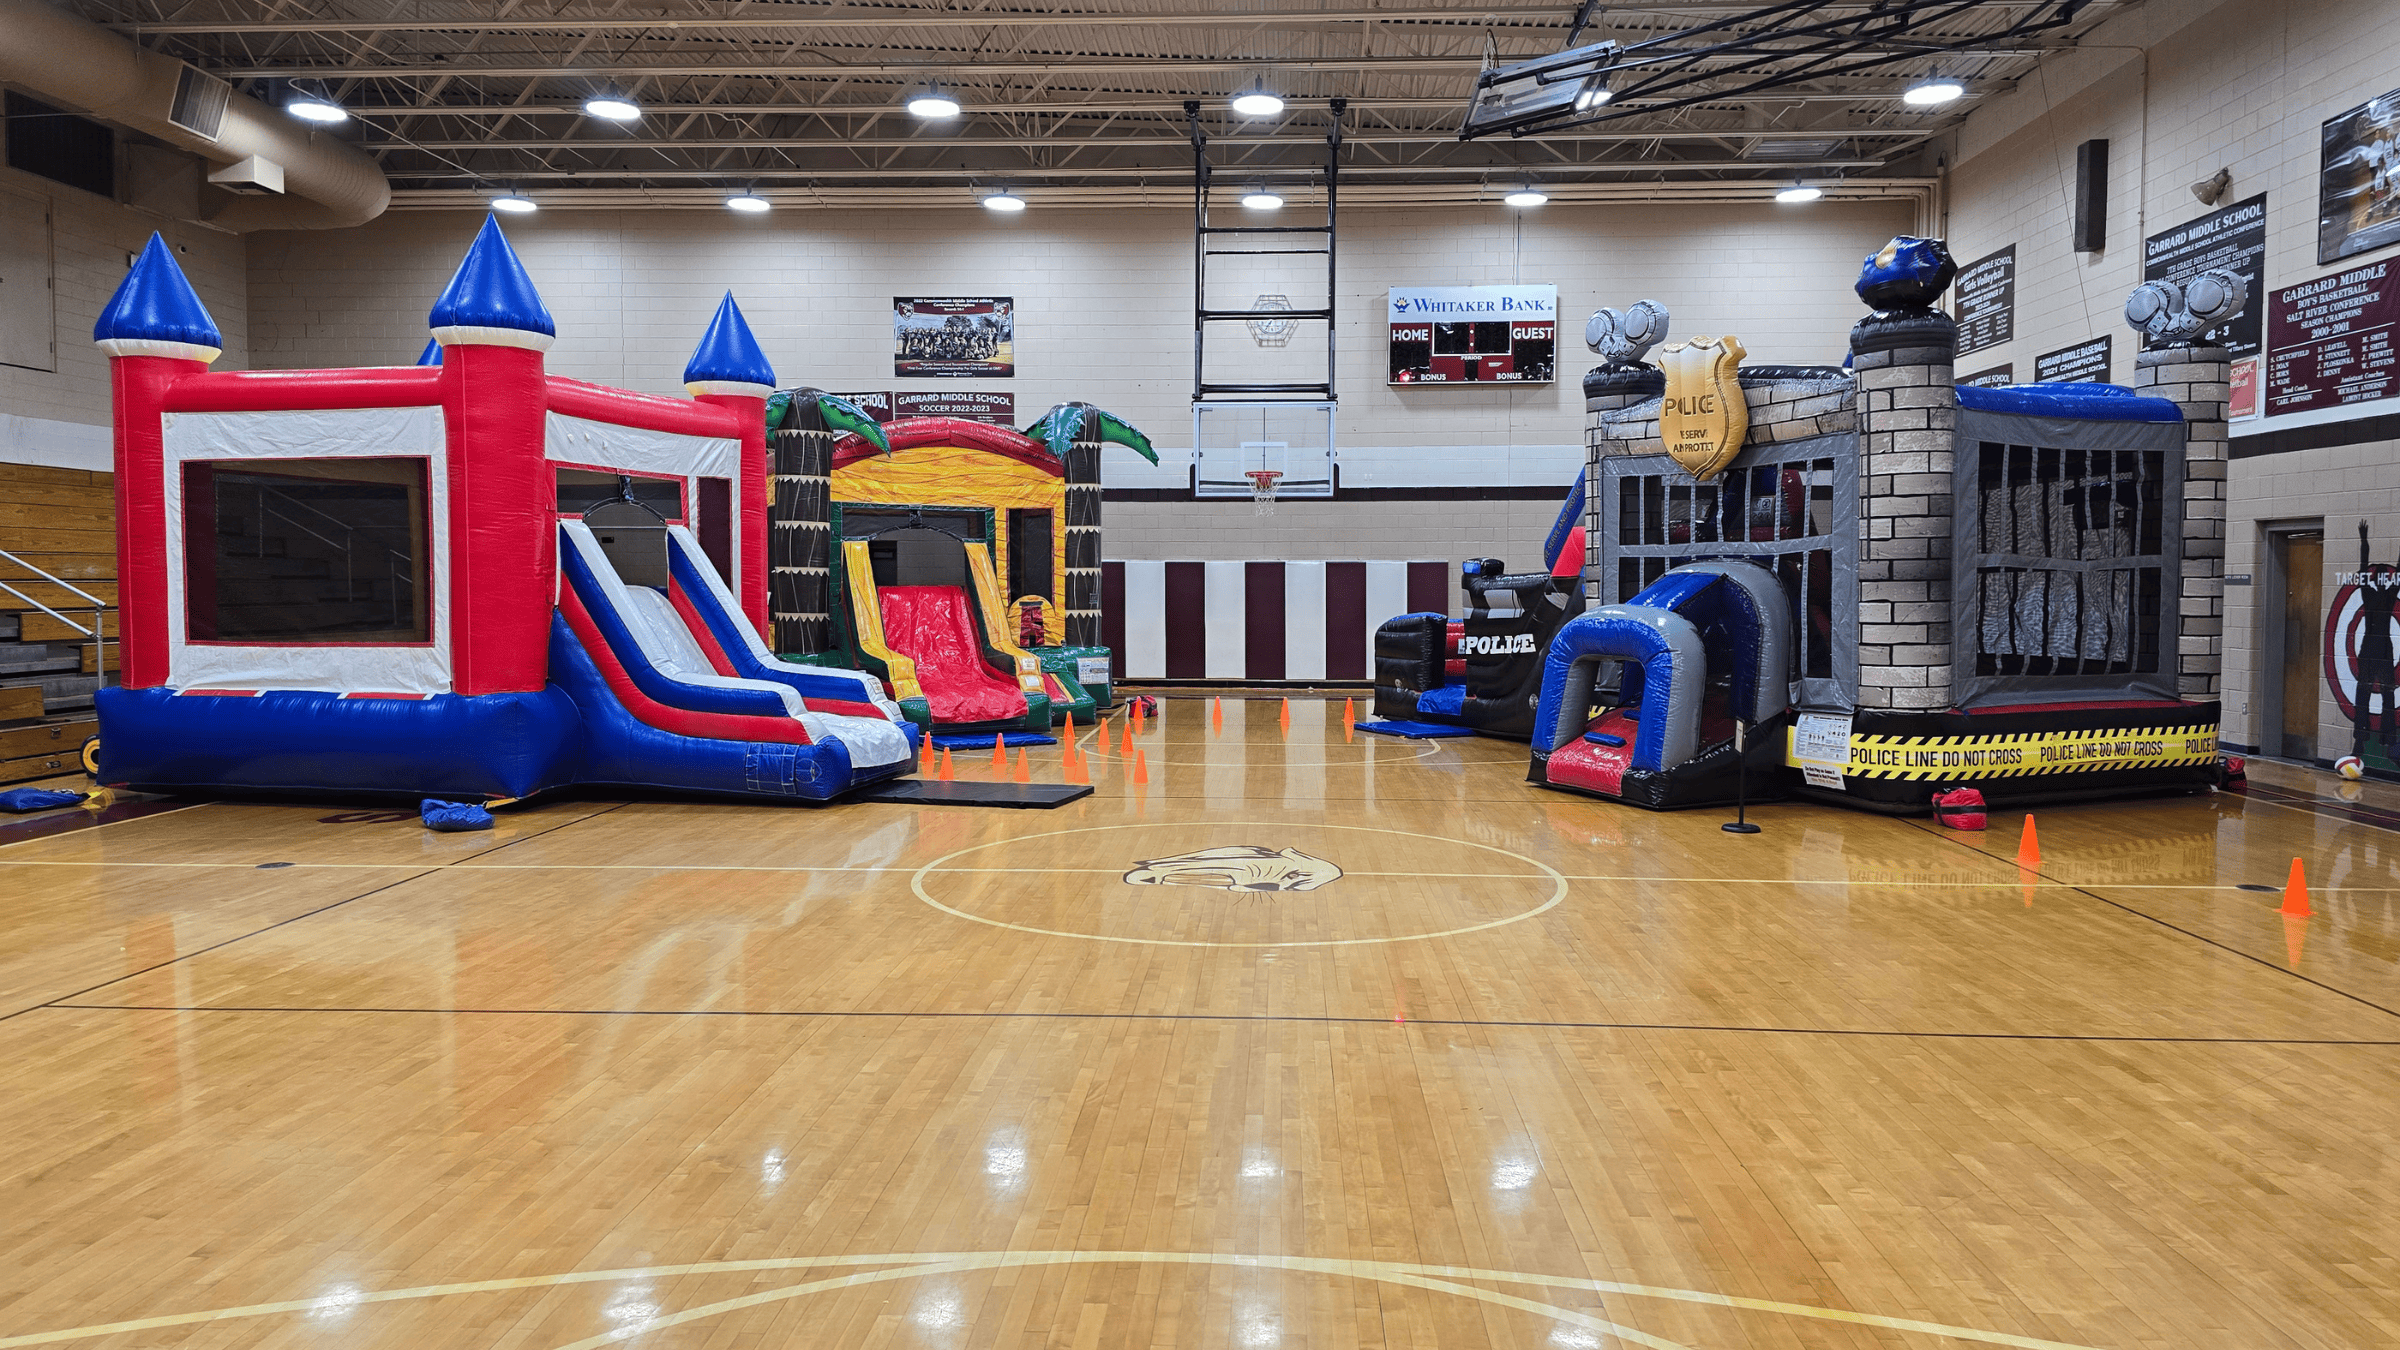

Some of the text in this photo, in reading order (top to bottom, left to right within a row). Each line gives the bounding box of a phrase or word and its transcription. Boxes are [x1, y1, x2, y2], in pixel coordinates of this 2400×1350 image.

[2148, 204, 2262, 256] GARRARD MIDDLE SCHOOL
[2179, 244, 2194, 254] MIDDLE
[2195, 239, 2212, 249] SCHOOL
[2212, 230, 2233, 243] ATHLETIC
[2233, 218, 2264, 235] CONFERENCE
[2177, 259, 2193, 271] GRADE
[2207, 243, 2239, 260] BASKETBALL
[2196, 254, 2231, 273] TOURNAMENT
[2232, 243, 2264, 261] CHAMPIONS
[2242, 257, 2250, 266] UP
[1957, 256, 2013, 287] GARRARD MIDDLE SCHOOL
[1964, 266, 2004, 292] Girls Volleyball
[2282, 278, 2337, 304] GARRARD
[2339, 263, 2387, 287] MIDDLE
[2319, 283, 2369, 304] BASKETBALL
[1413, 296, 1545, 313] WHITAKER BANK
[2286, 291, 2380, 323] SALT RIVER CONFERENCE
[2300, 308, 2362, 330] SEASON CHAMPIONS
[1392, 329, 1429, 341] HOME
[1512, 327, 1554, 340] GUEST
[2223, 325, 2230, 336] 3
[2311, 321, 2350, 339] 2000-2001
[2370, 331, 2389, 341] SMITH
[2038, 341, 2108, 369] GARRARD MIDDLE BASEBALL
[2370, 341, 2388, 351] SMITH
[2042, 353, 2103, 376] 2021 CHAMPIONS
[2088, 363, 2107, 372] SCHOOL
[1496, 372, 1522, 380] BONUS
[1992, 374, 2010, 383] SCHOOL
[854, 394, 889, 409] SCHOOL
[898, 393, 1011, 406] GARRARD MIDDLE SCHOOL
[1547, 530, 1560, 550] SERVE
[1558, 512, 1568, 530] AND
[1566, 480, 1583, 512] PROTECT
[2335, 572, 2373, 586] TARGET
[1465, 633, 1536, 655] POLICE
[2040, 740, 2163, 762] POLICE LINE DO NOT CROSS
[2185, 737, 2211, 754] POLICE
[1850, 747, 2022, 767] POLICE LINE DO NOT CROSS
